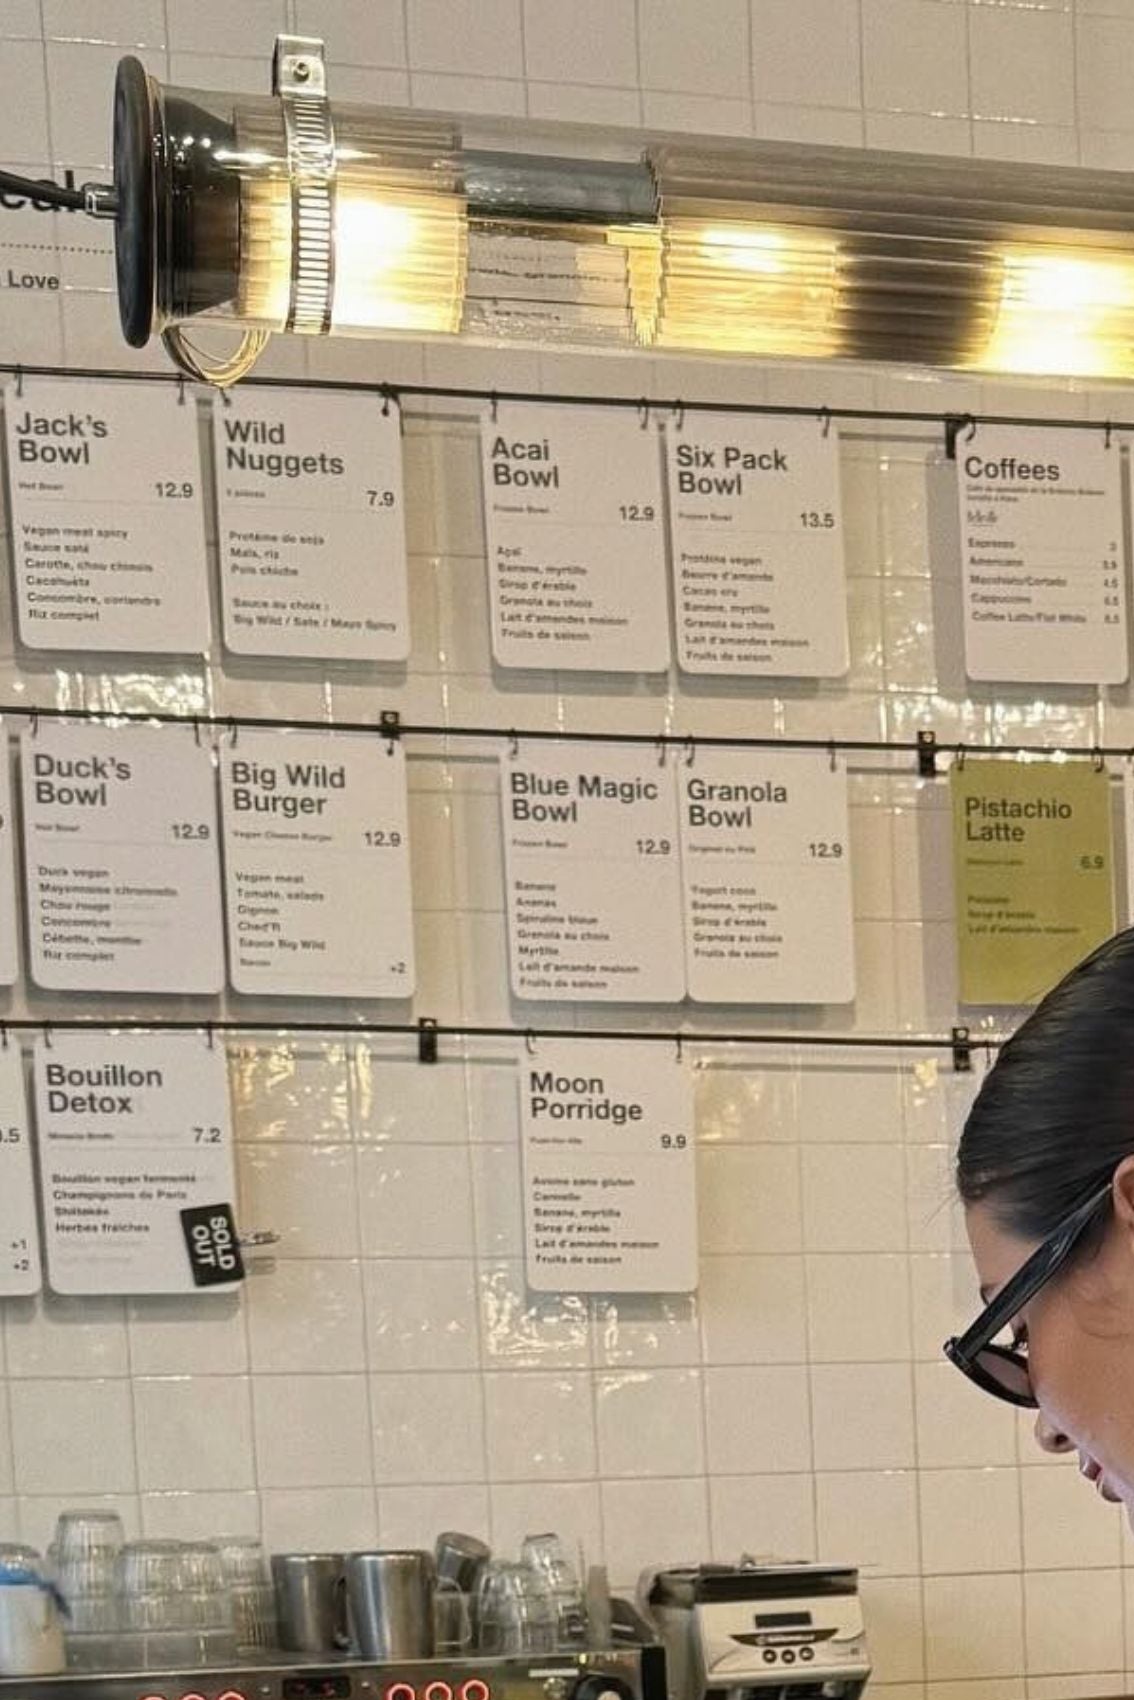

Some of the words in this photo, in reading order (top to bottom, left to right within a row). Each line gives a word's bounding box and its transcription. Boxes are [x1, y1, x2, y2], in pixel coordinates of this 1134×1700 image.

[8, 270, 59, 290] Love
[16, 412, 108, 438] Jack's
[225, 420, 285, 444] Wild
[18, 439, 89, 464] Bowl
[491, 437, 549, 461] Acai
[677, 444, 715, 468] Six
[725, 448, 788, 471] Pack
[227, 447, 344, 477] Nuggets
[965, 456, 1059, 480] Coffees
[493, 464, 558, 488] Bowl
[679, 472, 741, 495] Bowl
[155, 483, 193, 498] 12.9
[367, 491, 395, 507] 7.9
[620, 506, 654, 521] 12.9
[800, 513, 835, 529] 13.5
[34, 754, 131, 780] Duck's
[232, 762, 276, 790] Big
[286, 764, 345, 789] Wild
[36, 781, 106, 806] Bowl
[511, 773, 569, 796] Blue
[579, 775, 658, 804] Magic
[687, 779, 787, 802] Granola
[234, 789, 326, 818] Burger
[513, 799, 577, 822] Bowl
[966, 797, 1072, 819] Pistachio
[689, 805, 751, 828] Bowl
[171, 824, 210, 840] 12.9
[365, 831, 401, 847] 12.9
[967, 822, 1025, 842] Latte
[637, 839, 670, 855] 12.9
[809, 843, 843, 858] 12.9
[46, 1064, 162, 1087] Bouillon
[530, 1072, 604, 1094] Moon
[49, 1091, 133, 1114] Detox
[532, 1098, 642, 1125] Porridge
[193, 1128, 221, 1143] 7.2
[661, 1135, 686, 1149] 9.9
[192, 1226, 216, 1266] OUT
[211, 1216, 236, 1270] SOLD
